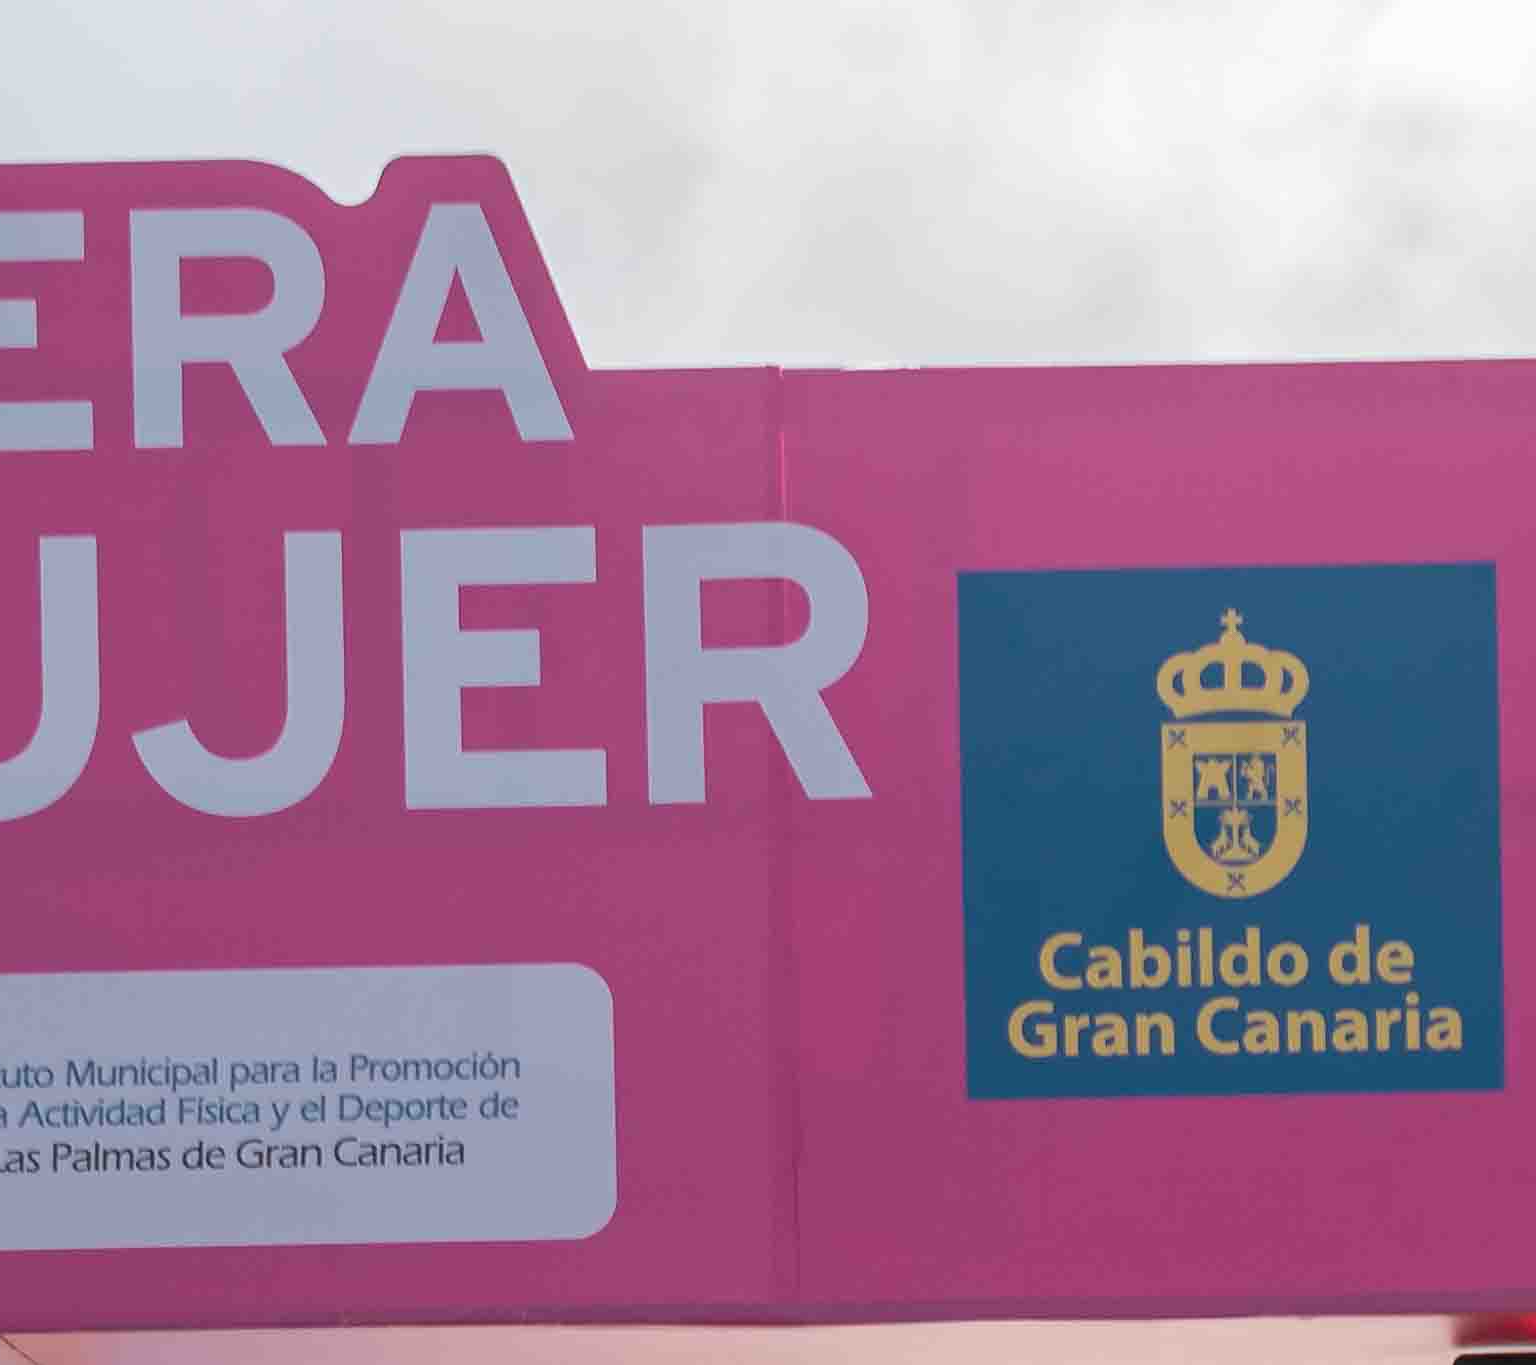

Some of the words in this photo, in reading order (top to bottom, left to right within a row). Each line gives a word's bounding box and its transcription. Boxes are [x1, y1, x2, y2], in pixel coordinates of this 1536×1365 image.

[1039, 926, 1309, 990] Cabildo
[1328, 924, 1415, 986] de
[1008, 1000, 1175, 1058] Gran
[1196, 990, 1462, 1055] Canaria
[66, 1055, 218, 1092] Municipal
[229, 1061, 300, 1092] para
[312, 1055, 338, 1084] la
[350, 1051, 521, 1083] Promoción
[17, 1097, 166, 1130] Actividad
[178, 1095, 261, 1126] Física
[270, 1100, 291, 1132] y
[300, 1095, 326, 1124] el
[338, 1092, 468, 1130] Deporte
[479, 1090, 519, 1121] de
[52, 1140, 171, 1173] Palmas
[181, 1139, 226, 1171] de
[235, 1138, 323, 1170] Gran
[333, 1135, 465, 1167] Canaria
